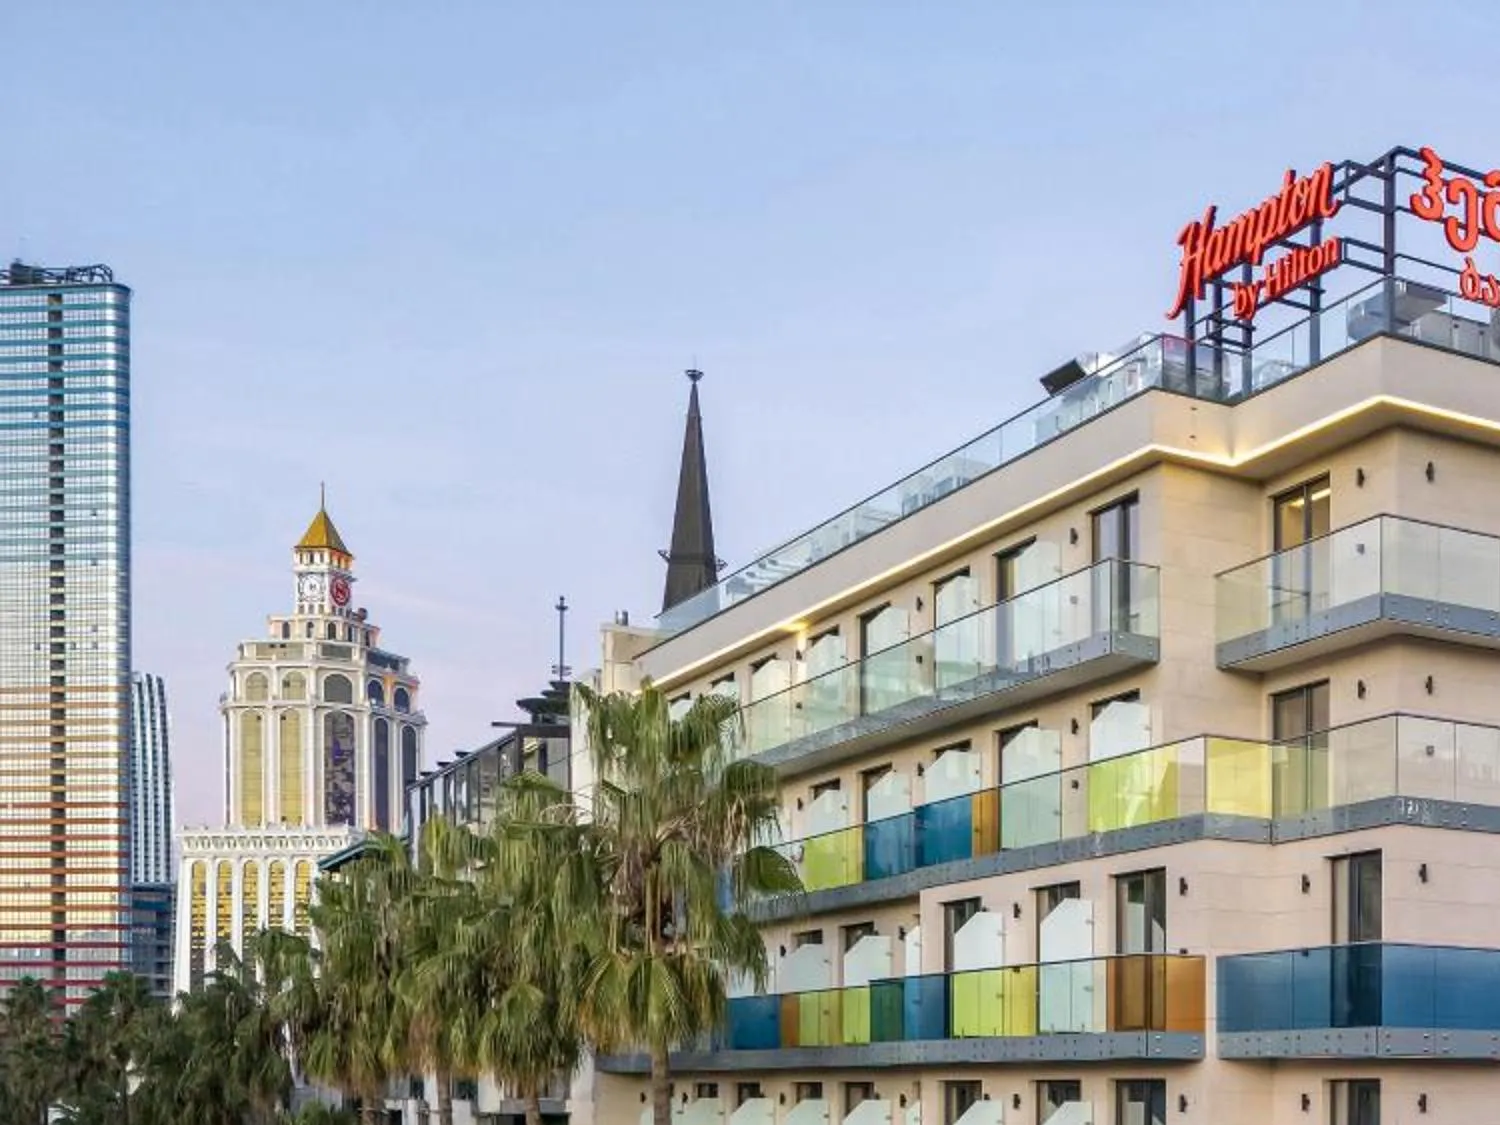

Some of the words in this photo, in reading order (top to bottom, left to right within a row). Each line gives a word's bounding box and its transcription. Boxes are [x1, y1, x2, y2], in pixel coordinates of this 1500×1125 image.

[1166, 161, 1341, 320] Hampton
[1233, 281, 1260, 319] by
[1264, 236, 1341, 299] Hilton
